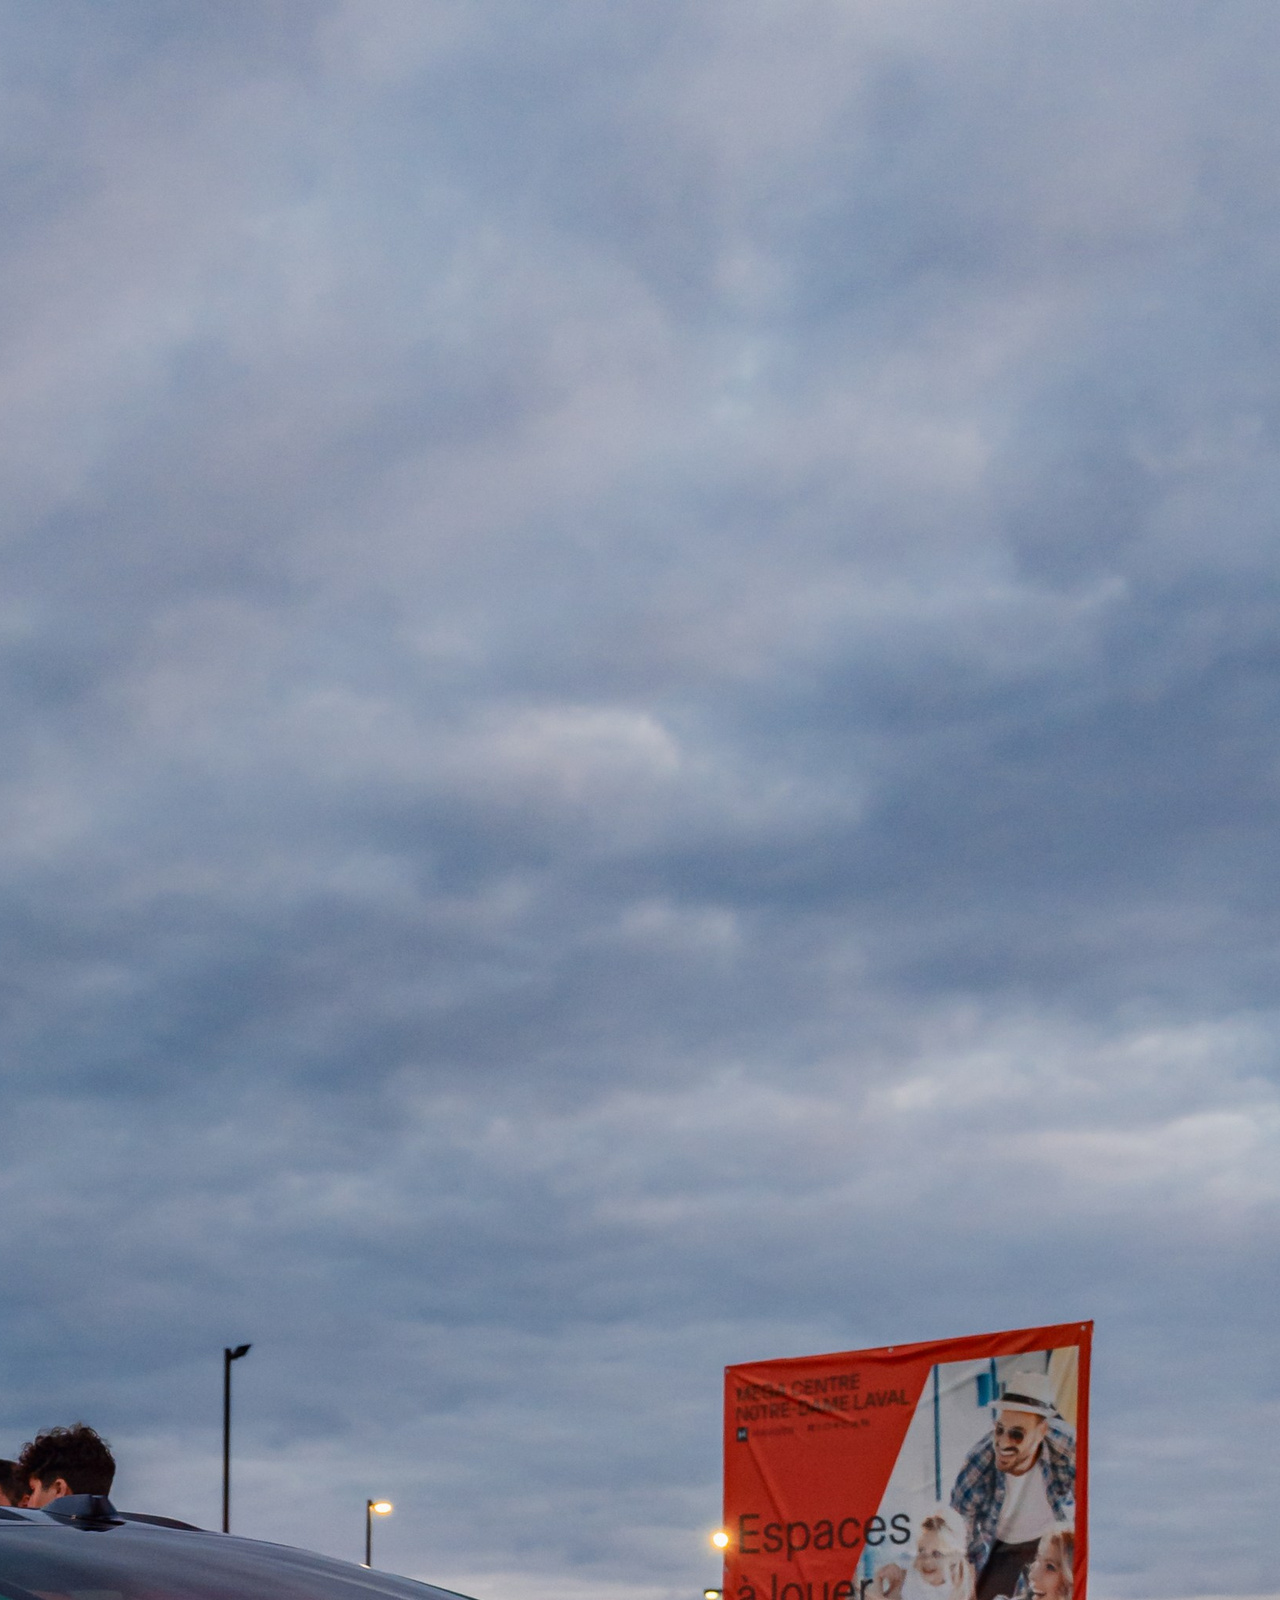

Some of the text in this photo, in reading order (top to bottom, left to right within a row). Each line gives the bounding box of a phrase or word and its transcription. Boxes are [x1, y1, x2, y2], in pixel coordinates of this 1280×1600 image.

[792, 1373, 861, 1396] CENTRE
[854, 1389, 909, 1410] LAVAL
[739, 1513, 911, 1561] Espaces
